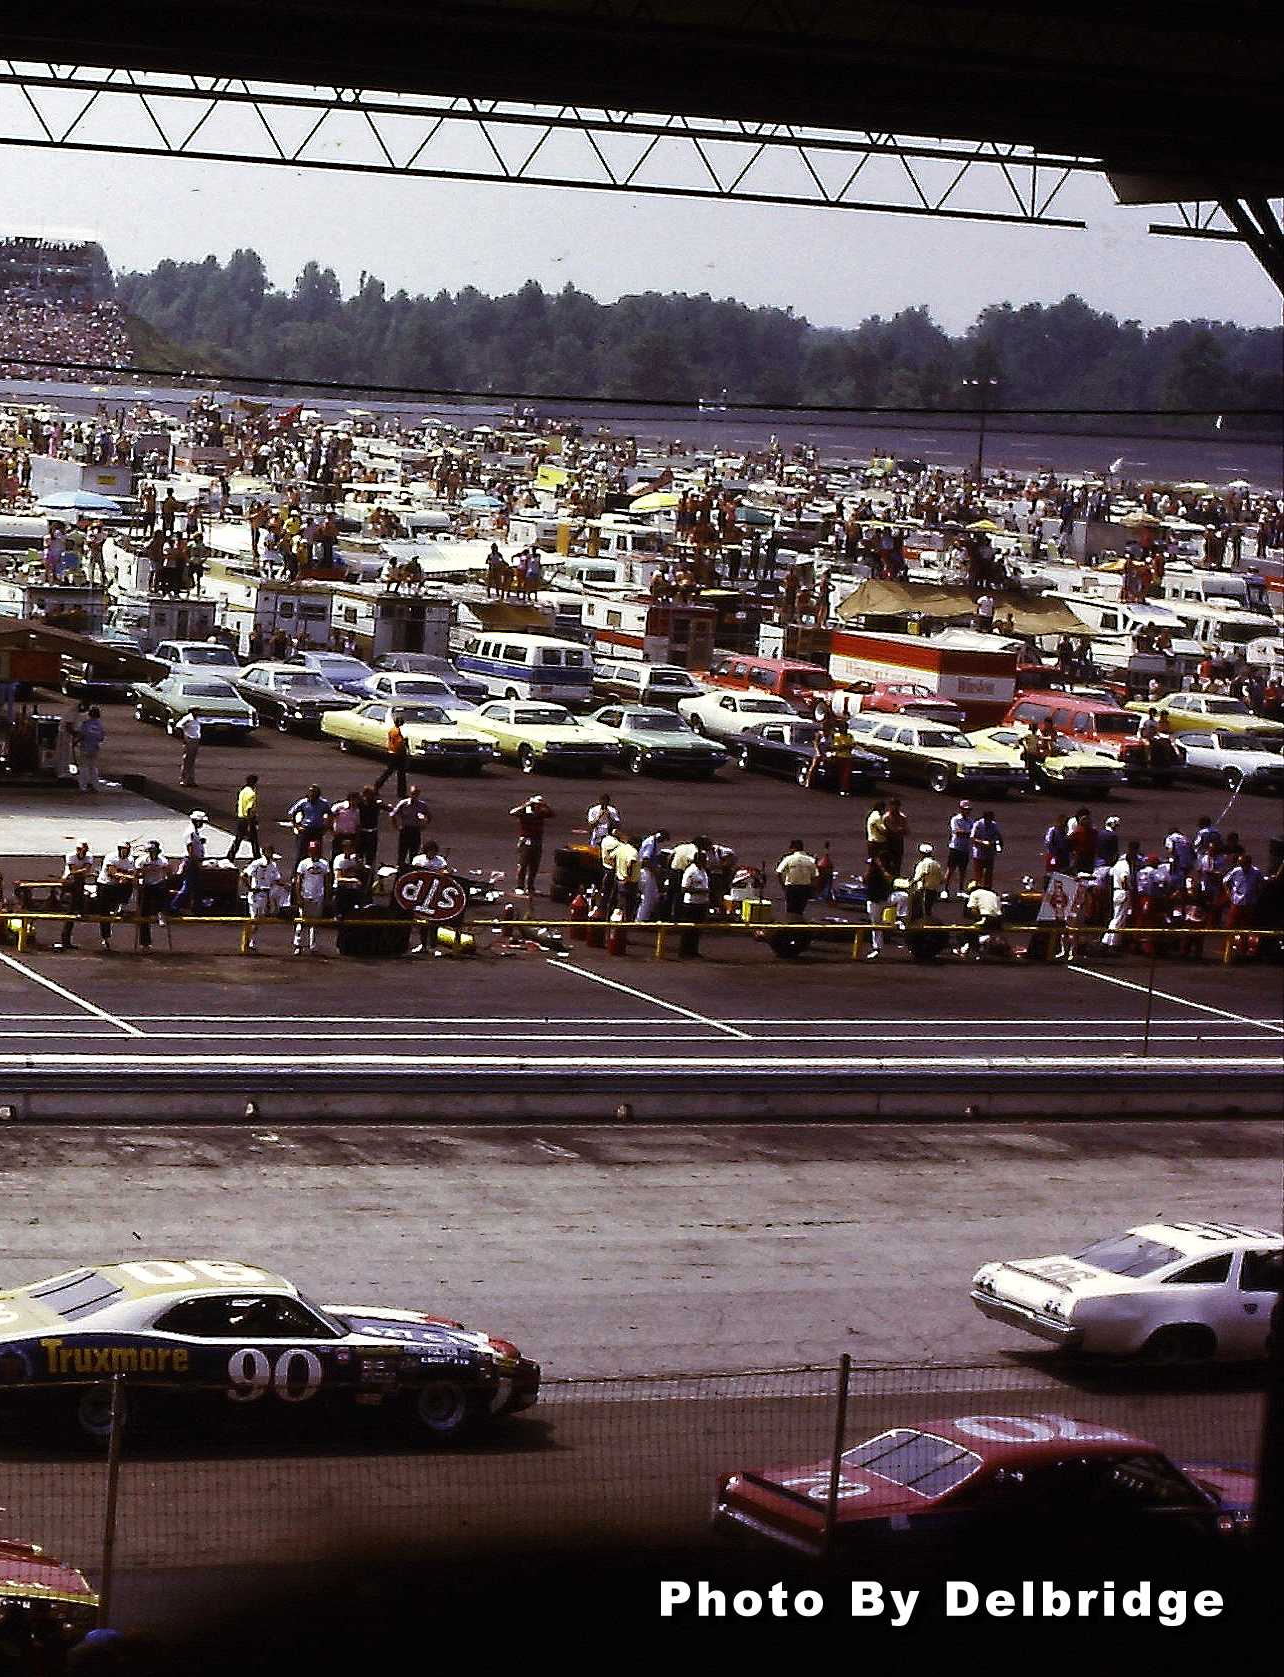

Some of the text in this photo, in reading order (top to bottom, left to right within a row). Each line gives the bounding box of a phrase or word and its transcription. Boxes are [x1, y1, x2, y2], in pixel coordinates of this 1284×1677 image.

[401, 879, 459, 915] STP
[40, 1338, 189, 1374] Truxmore
[228, 1347, 322, 1401] 90
